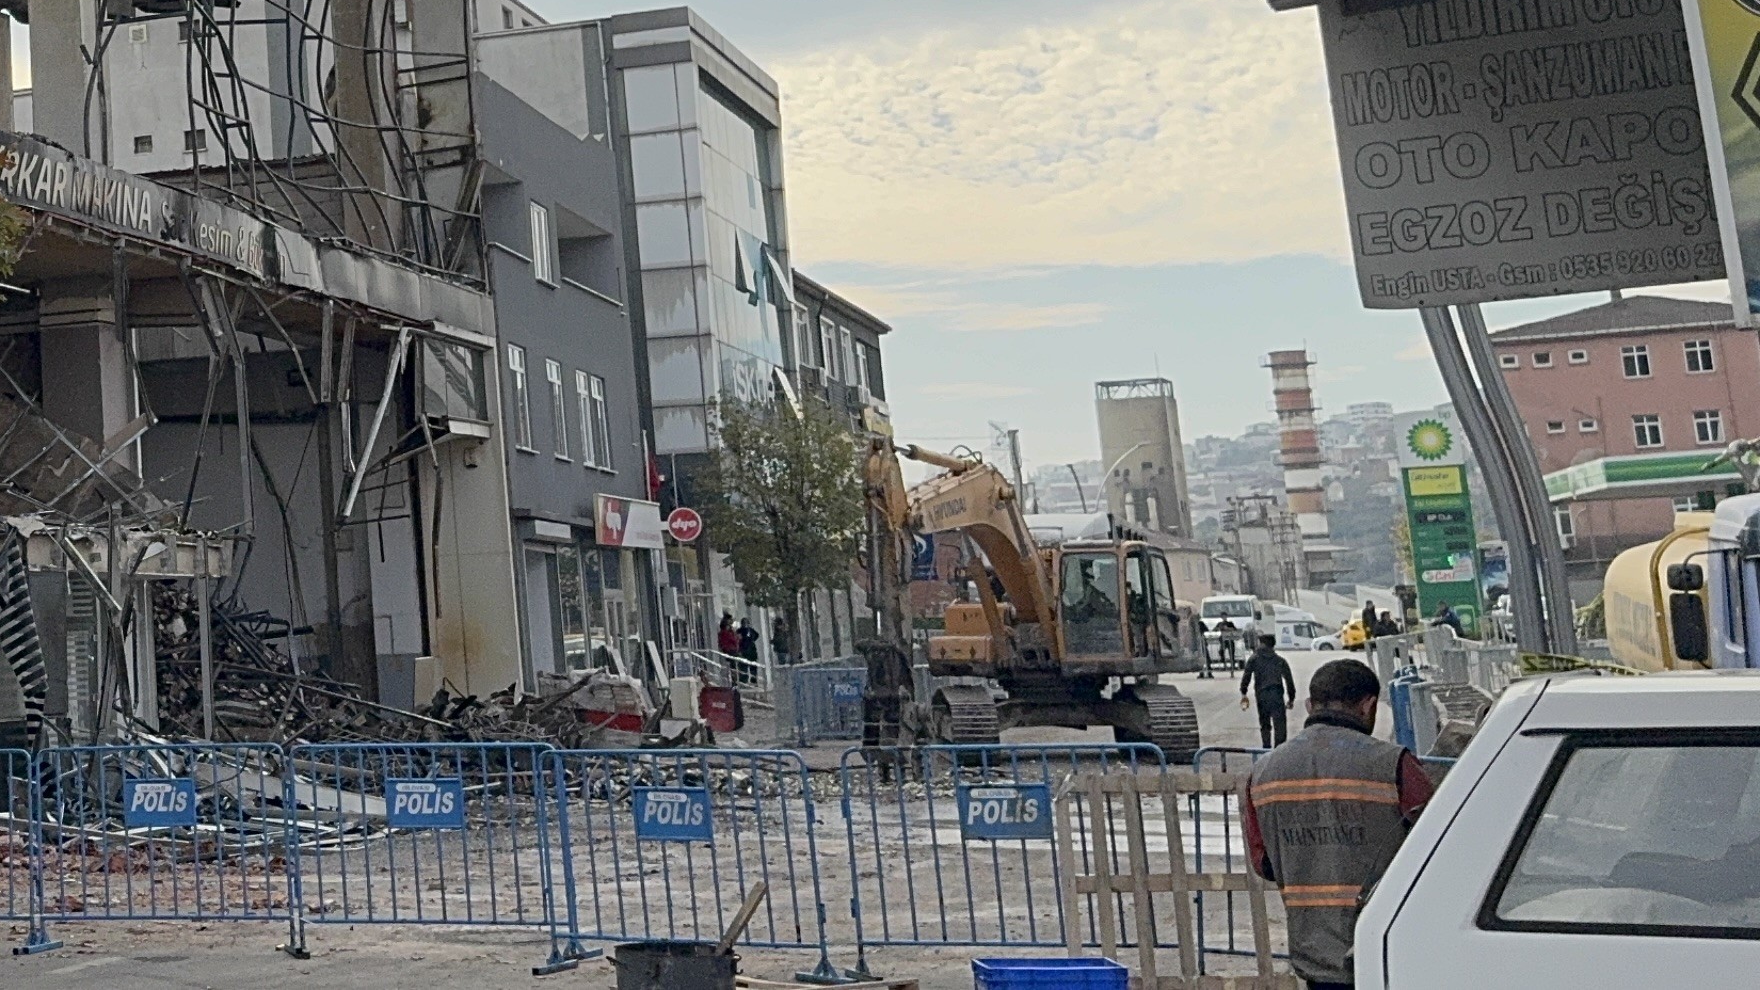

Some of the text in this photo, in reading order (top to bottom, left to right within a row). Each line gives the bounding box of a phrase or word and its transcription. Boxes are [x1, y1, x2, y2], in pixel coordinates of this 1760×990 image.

[1340, 60, 1459, 126] MOTOR
[1479, 31, 1671, 123] ŞANZUMAN
[1355, 130, 1491, 189] OTO
[1356, 196, 1533, 257] EGZOZ
[1371, 271, 1429, 300] Engin
[1431, 265, 1486, 294] USTA
[1560, 251, 1614, 281] 0535
[1661, 244, 1691, 271] 60
[131, 786, 188, 812] POLİS
[394, 787, 454, 815] POLİS
[643, 798, 704, 825] POLİS
[967, 793, 1039, 825] POLİS
